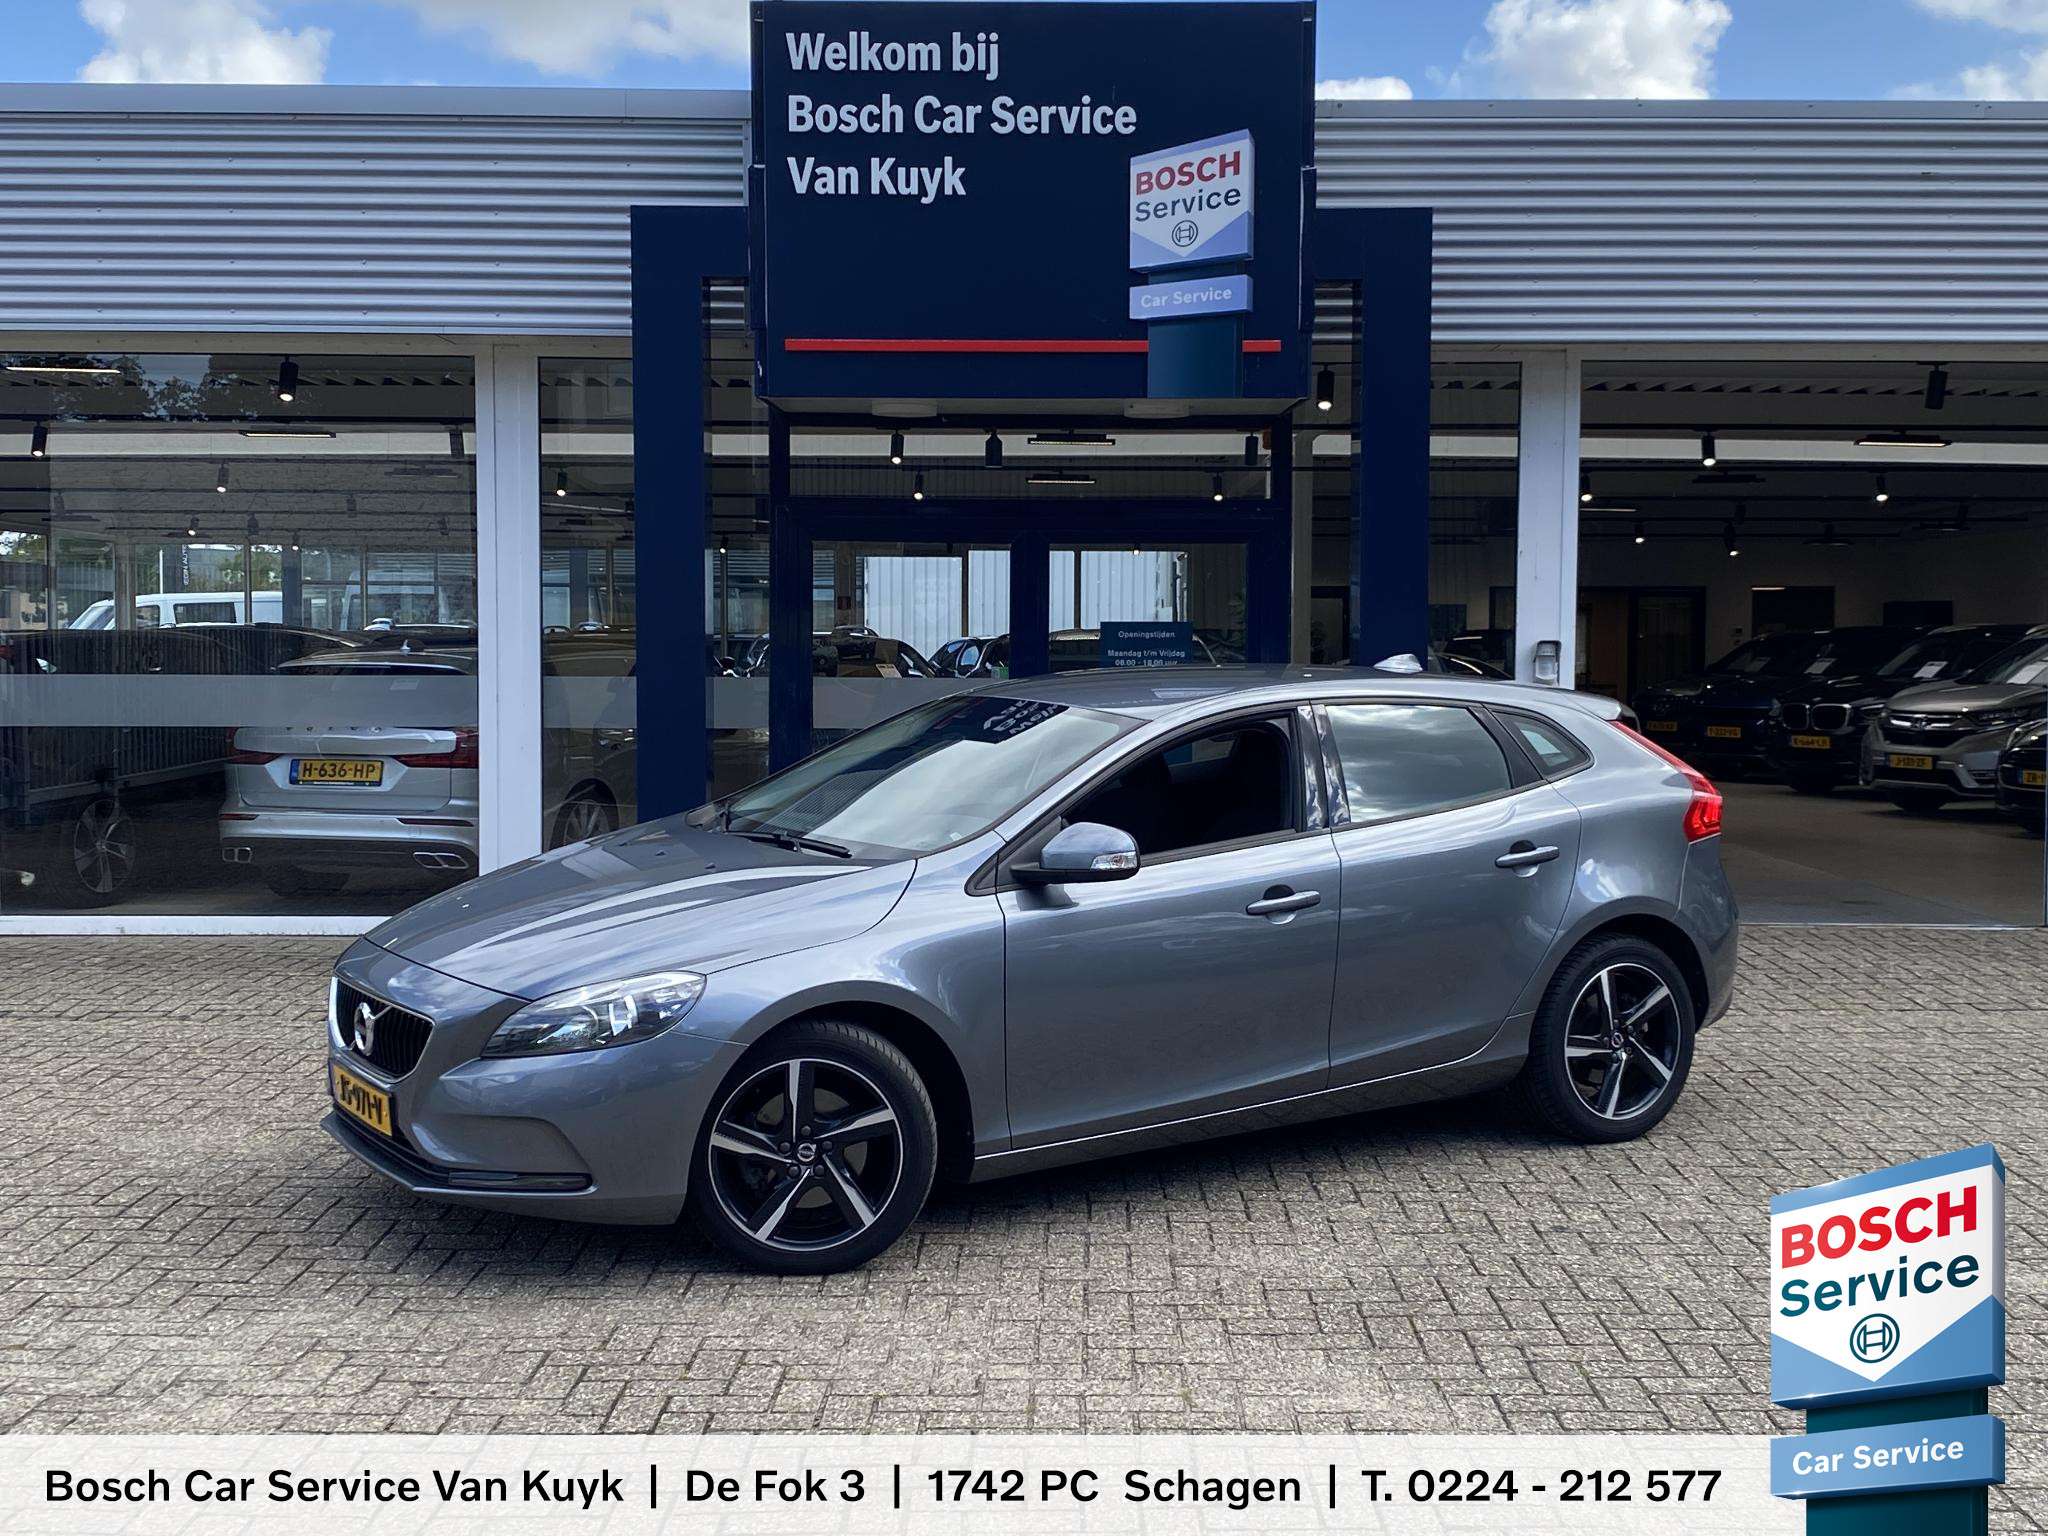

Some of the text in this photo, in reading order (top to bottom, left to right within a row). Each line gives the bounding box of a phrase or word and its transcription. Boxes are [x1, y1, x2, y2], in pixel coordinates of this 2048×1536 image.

[786, 31, 999, 80] Welkom bij
[788, 94, 1137, 134] Bosch Car Service
[787, 156, 966, 204] Van Kuyk
[1136, 151, 1240, 195] BOSCH
[1135, 187, 1241, 222] Service
[1141, 287, 1232, 308] Car Service
[1118, 630, 1175, 639] Openingstijden
[1107, 649, 1141, 658] Maandag
[1159, 649, 1185, 658] Vrijdag
[302, 762, 376, 779] H-636-HP
